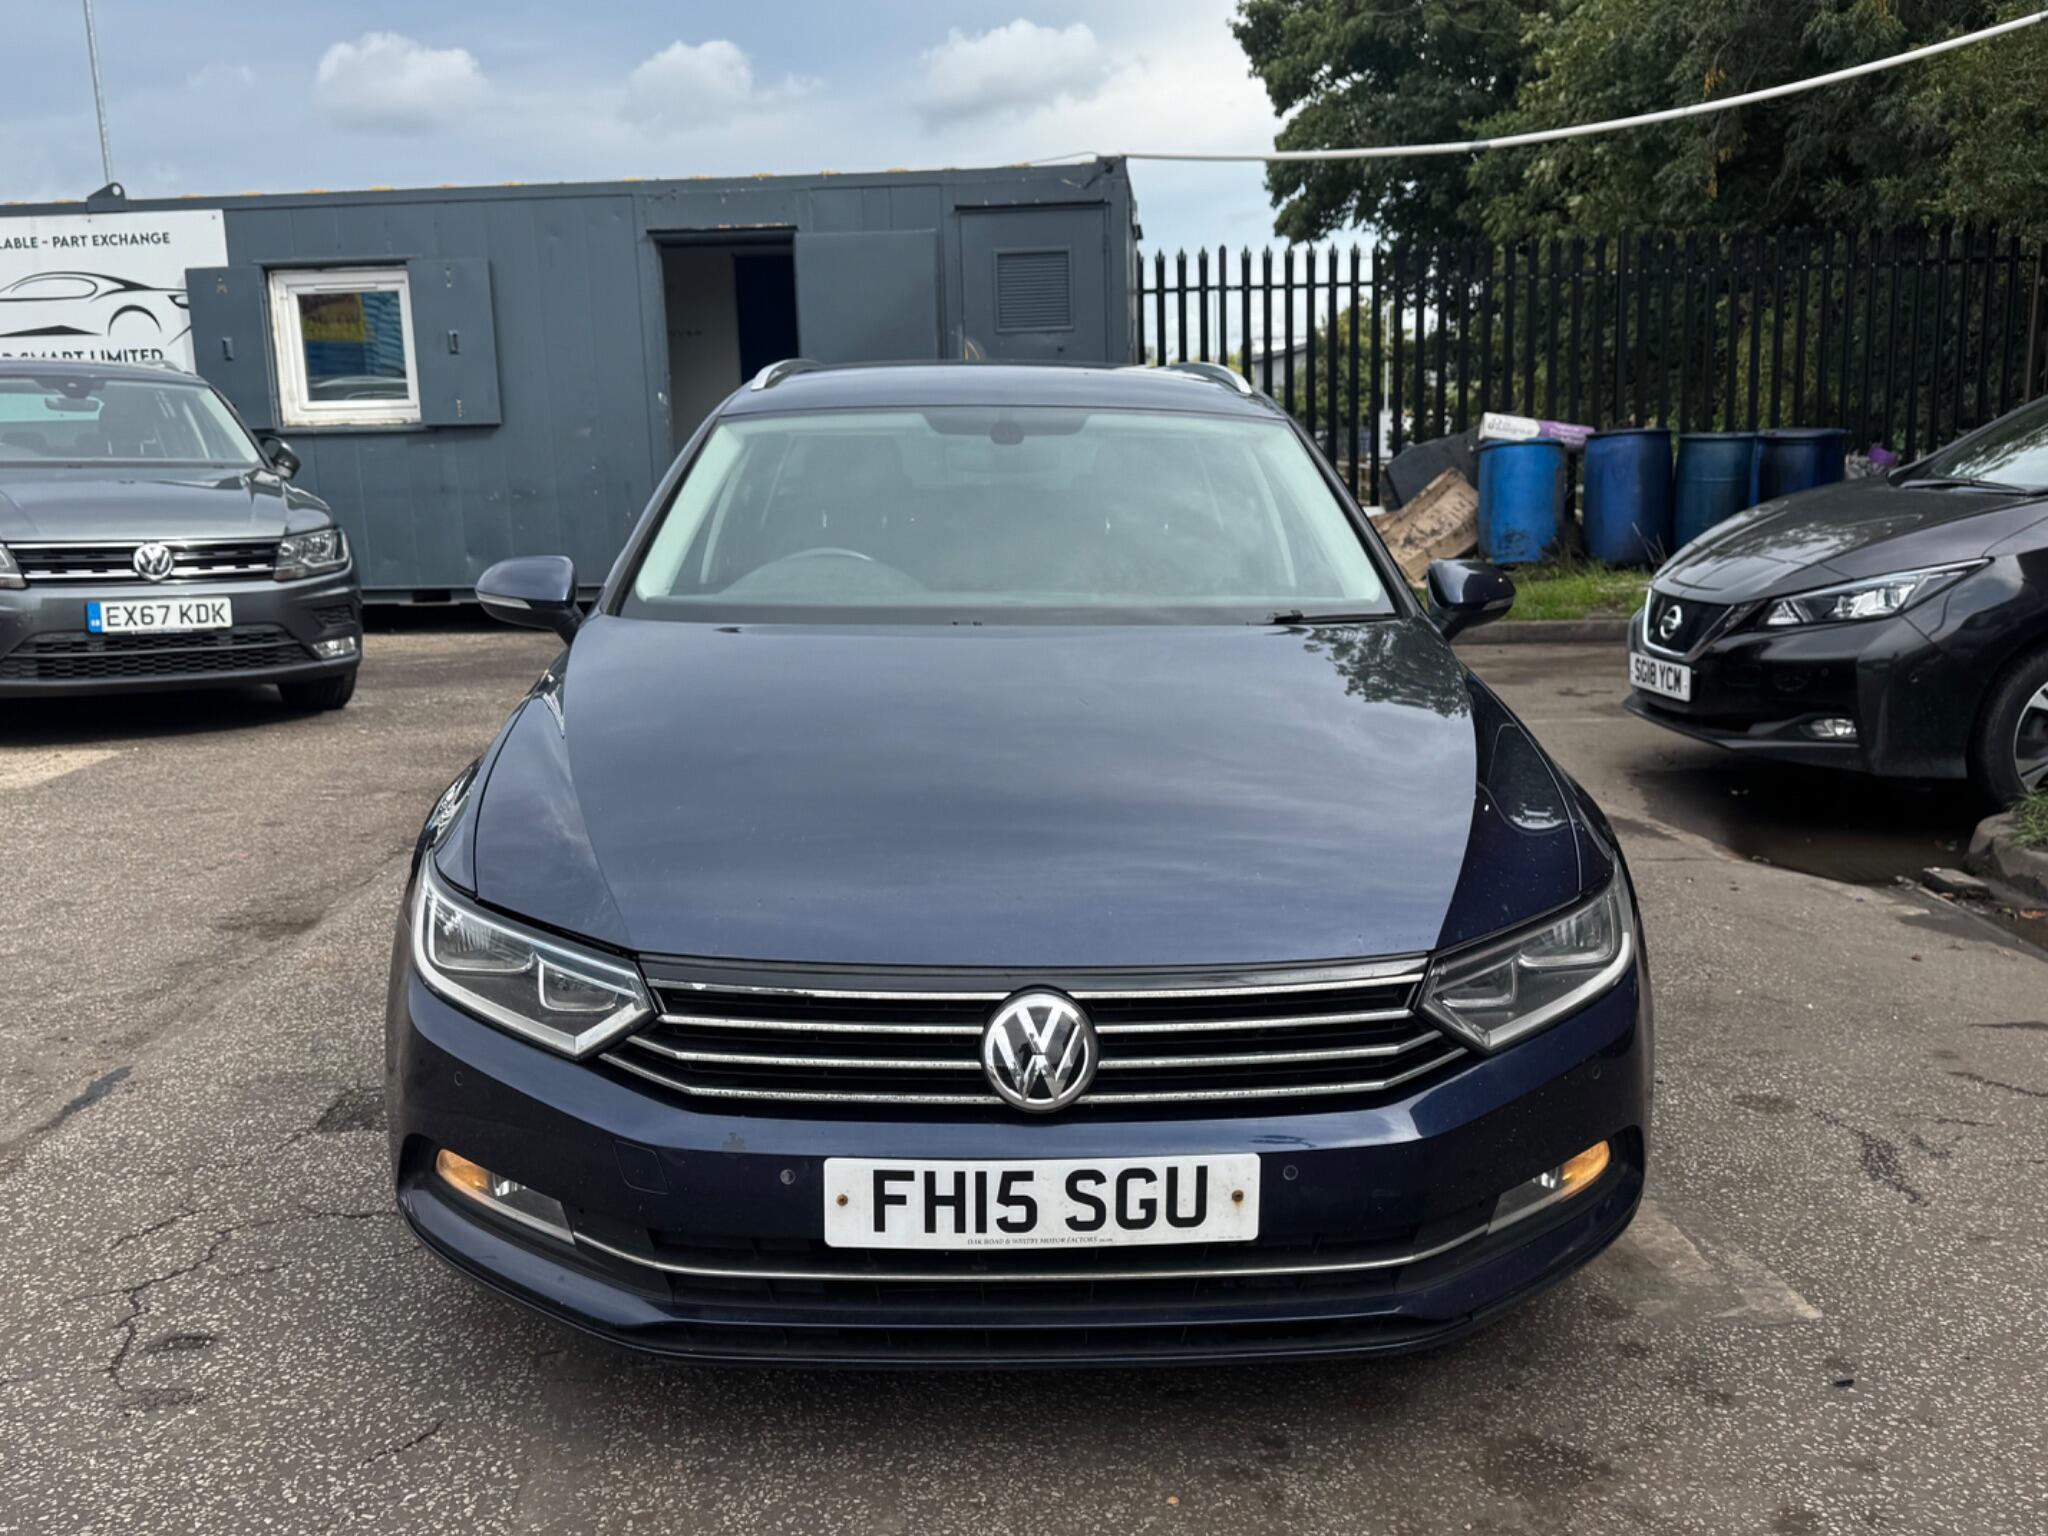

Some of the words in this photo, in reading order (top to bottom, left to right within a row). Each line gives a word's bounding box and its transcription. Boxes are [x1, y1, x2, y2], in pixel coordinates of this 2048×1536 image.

[0, 237, 38, 249] ABLE
[52, 235, 88, 248] PART
[92, 232, 171, 247] EXCHANGE
[105, 604, 170, 627] EX67
[178, 603, 226, 625] KDK
[872, 1169, 1038, 1234] FH15
[1064, 1165, 1208, 1233] SGU
